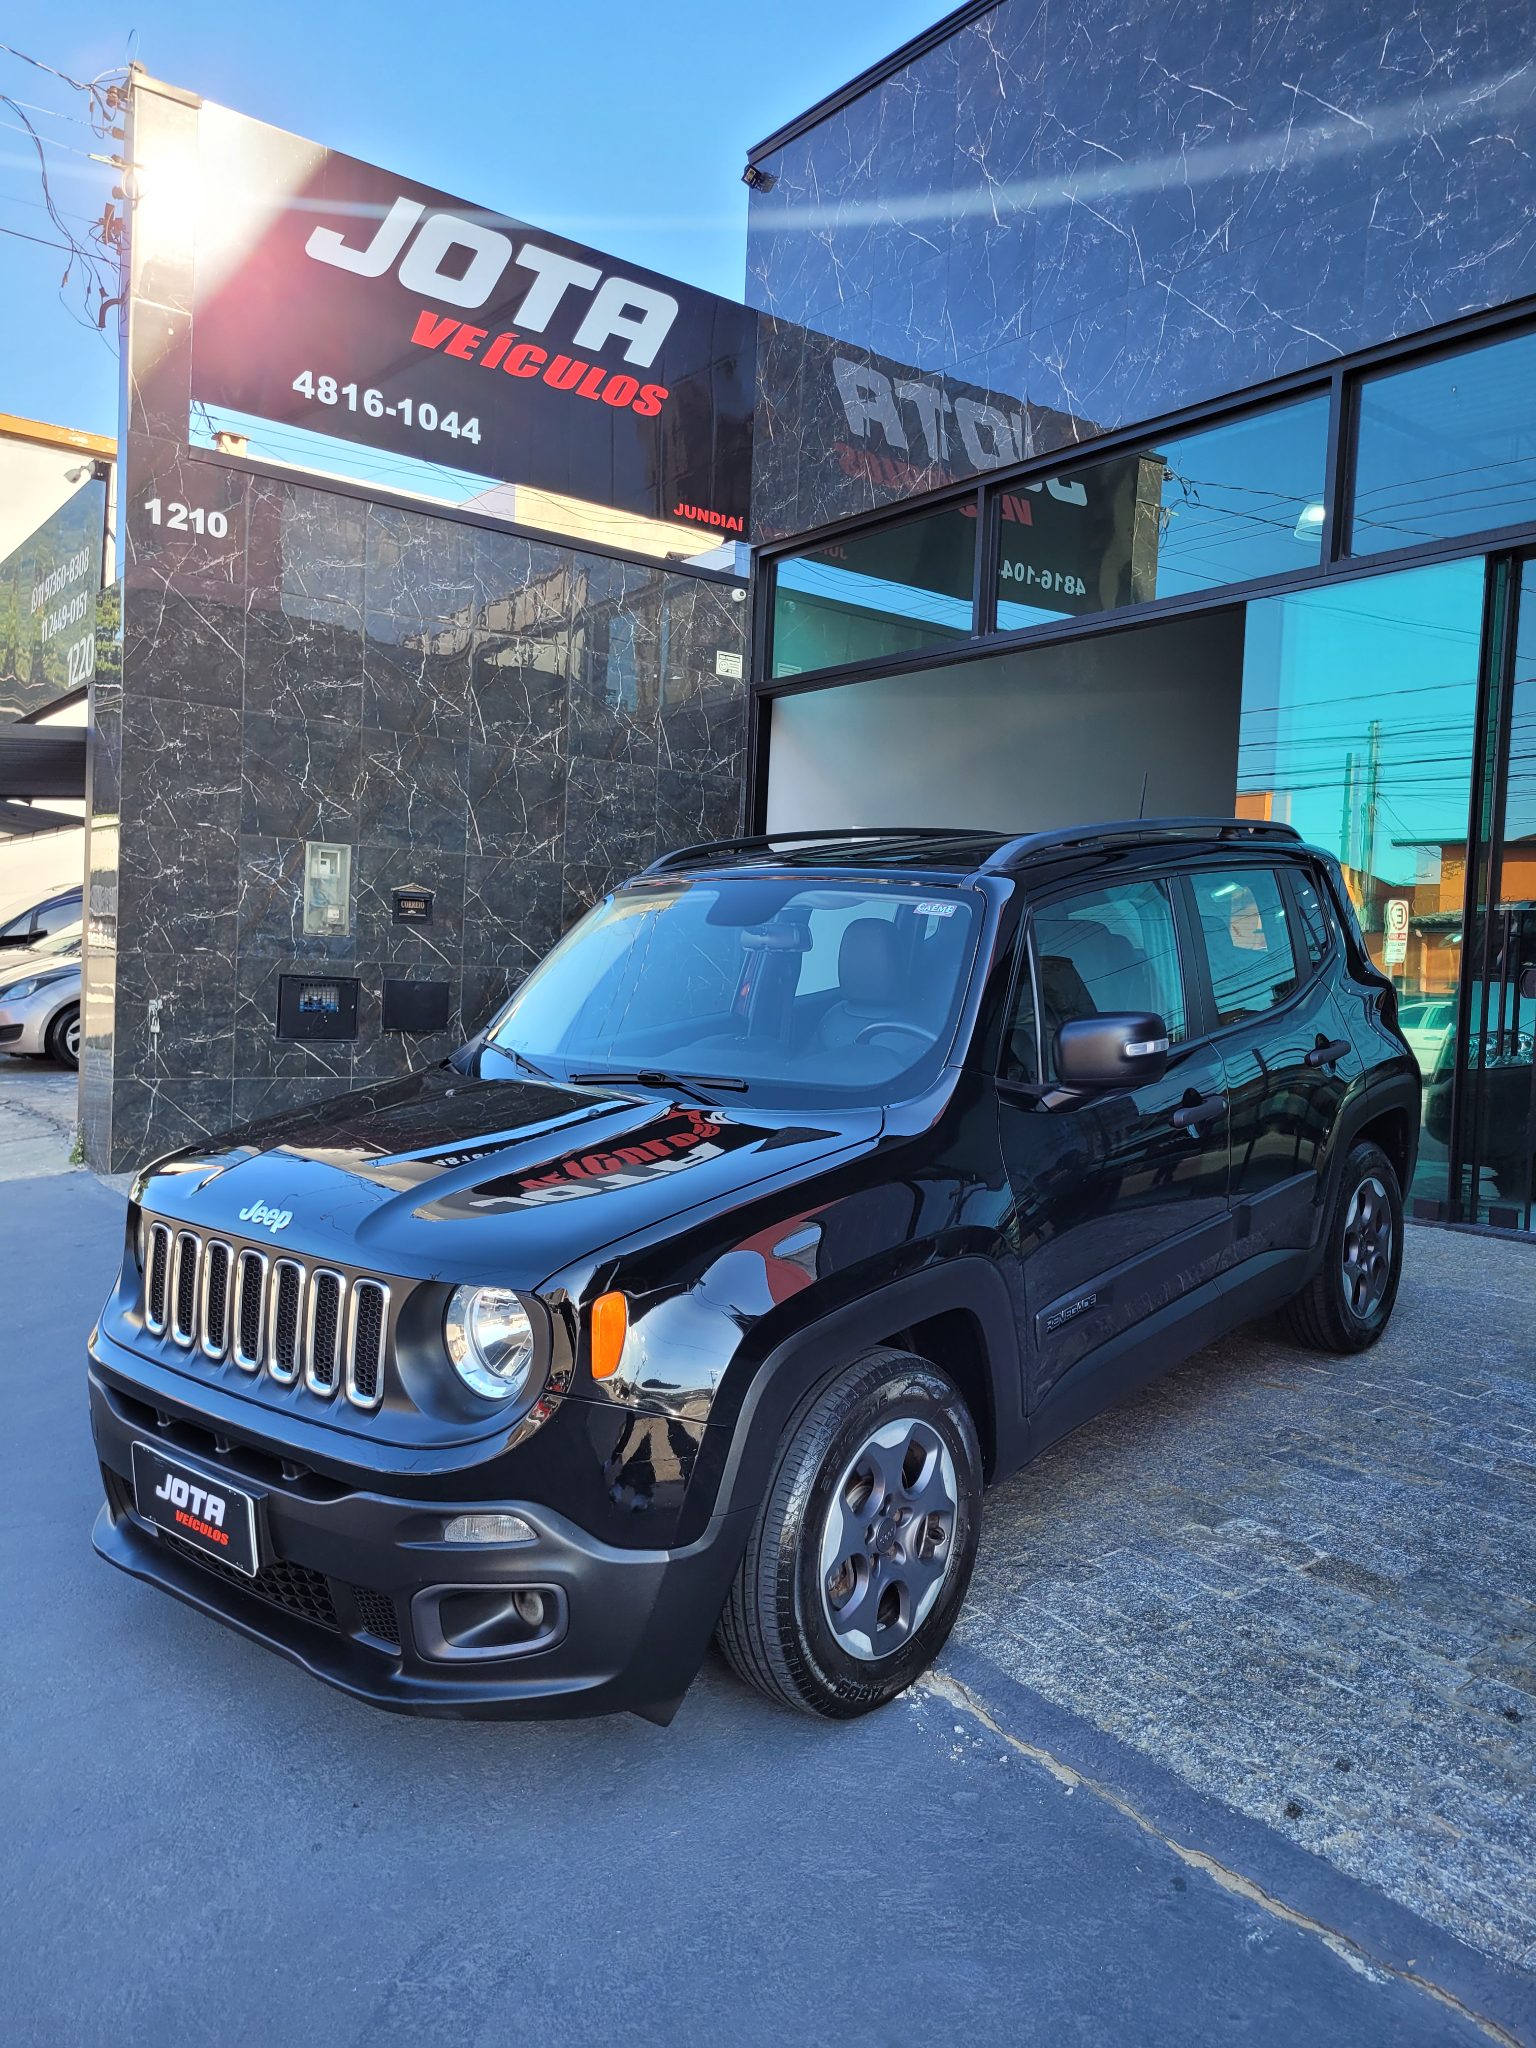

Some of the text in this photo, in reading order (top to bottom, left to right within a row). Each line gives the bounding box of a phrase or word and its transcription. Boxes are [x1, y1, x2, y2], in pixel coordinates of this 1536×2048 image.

[305, 196, 679, 368] JOTA
[410, 310, 669, 418] VEÍCULOS
[292, 370, 482, 445] 4816-1044
[145, 498, 228, 539] 1210
[673, 502, 744, 532] JUNDIAÍ
[67, 632, 95, 688] 1220
[239, 1199, 294, 1234] Jeep
[155, 1473, 226, 1527] JOTA
[175, 1509, 230, 1546] VEÍCULOS
